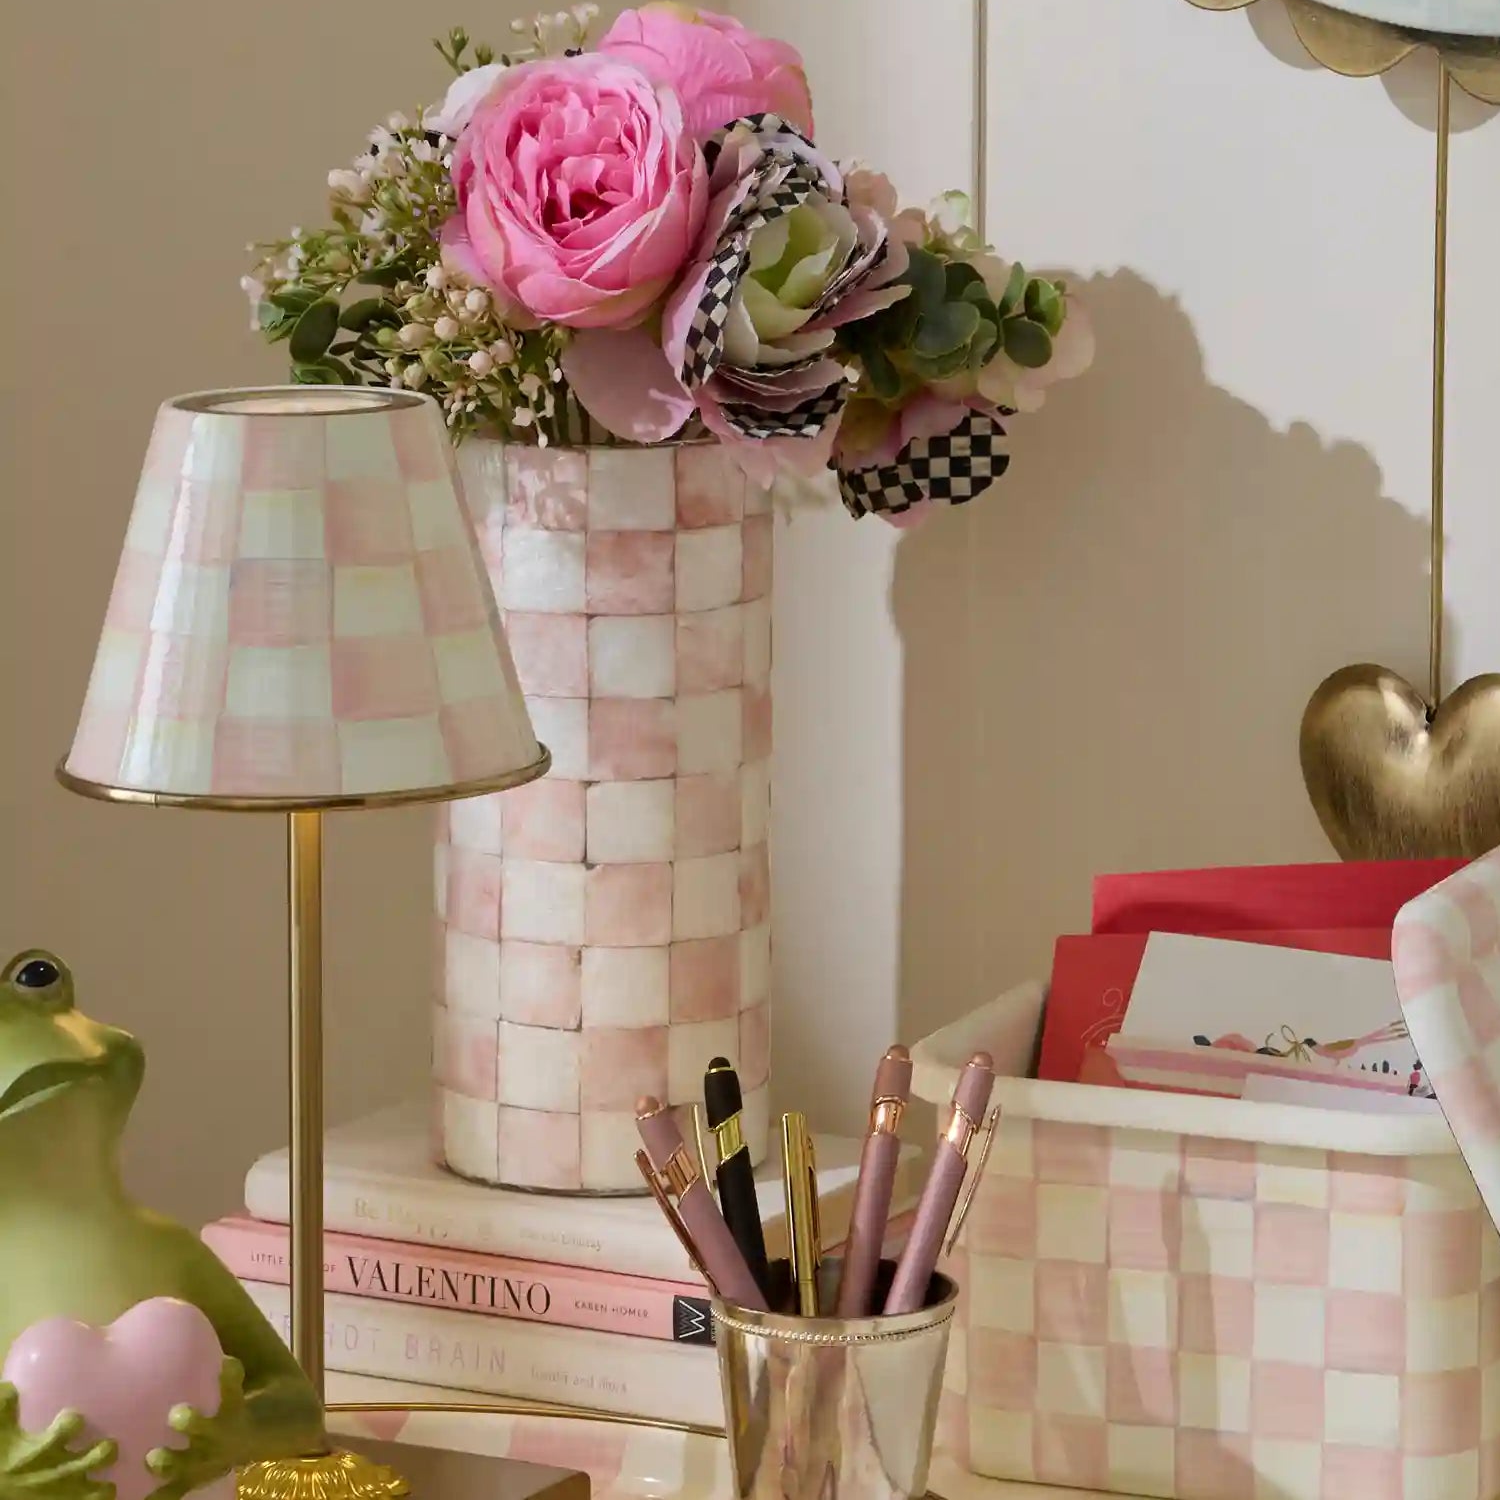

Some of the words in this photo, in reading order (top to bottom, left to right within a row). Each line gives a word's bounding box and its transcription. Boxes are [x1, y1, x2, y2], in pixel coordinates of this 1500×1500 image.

[250, 1249, 284, 1266] LITTLE
[346, 1256, 551, 1316] VALENTINO
[574, 1300, 607, 1313] KAREN
[611, 1307, 649, 1318] HOMER
[405, 1333, 505, 1375] BRAIN
